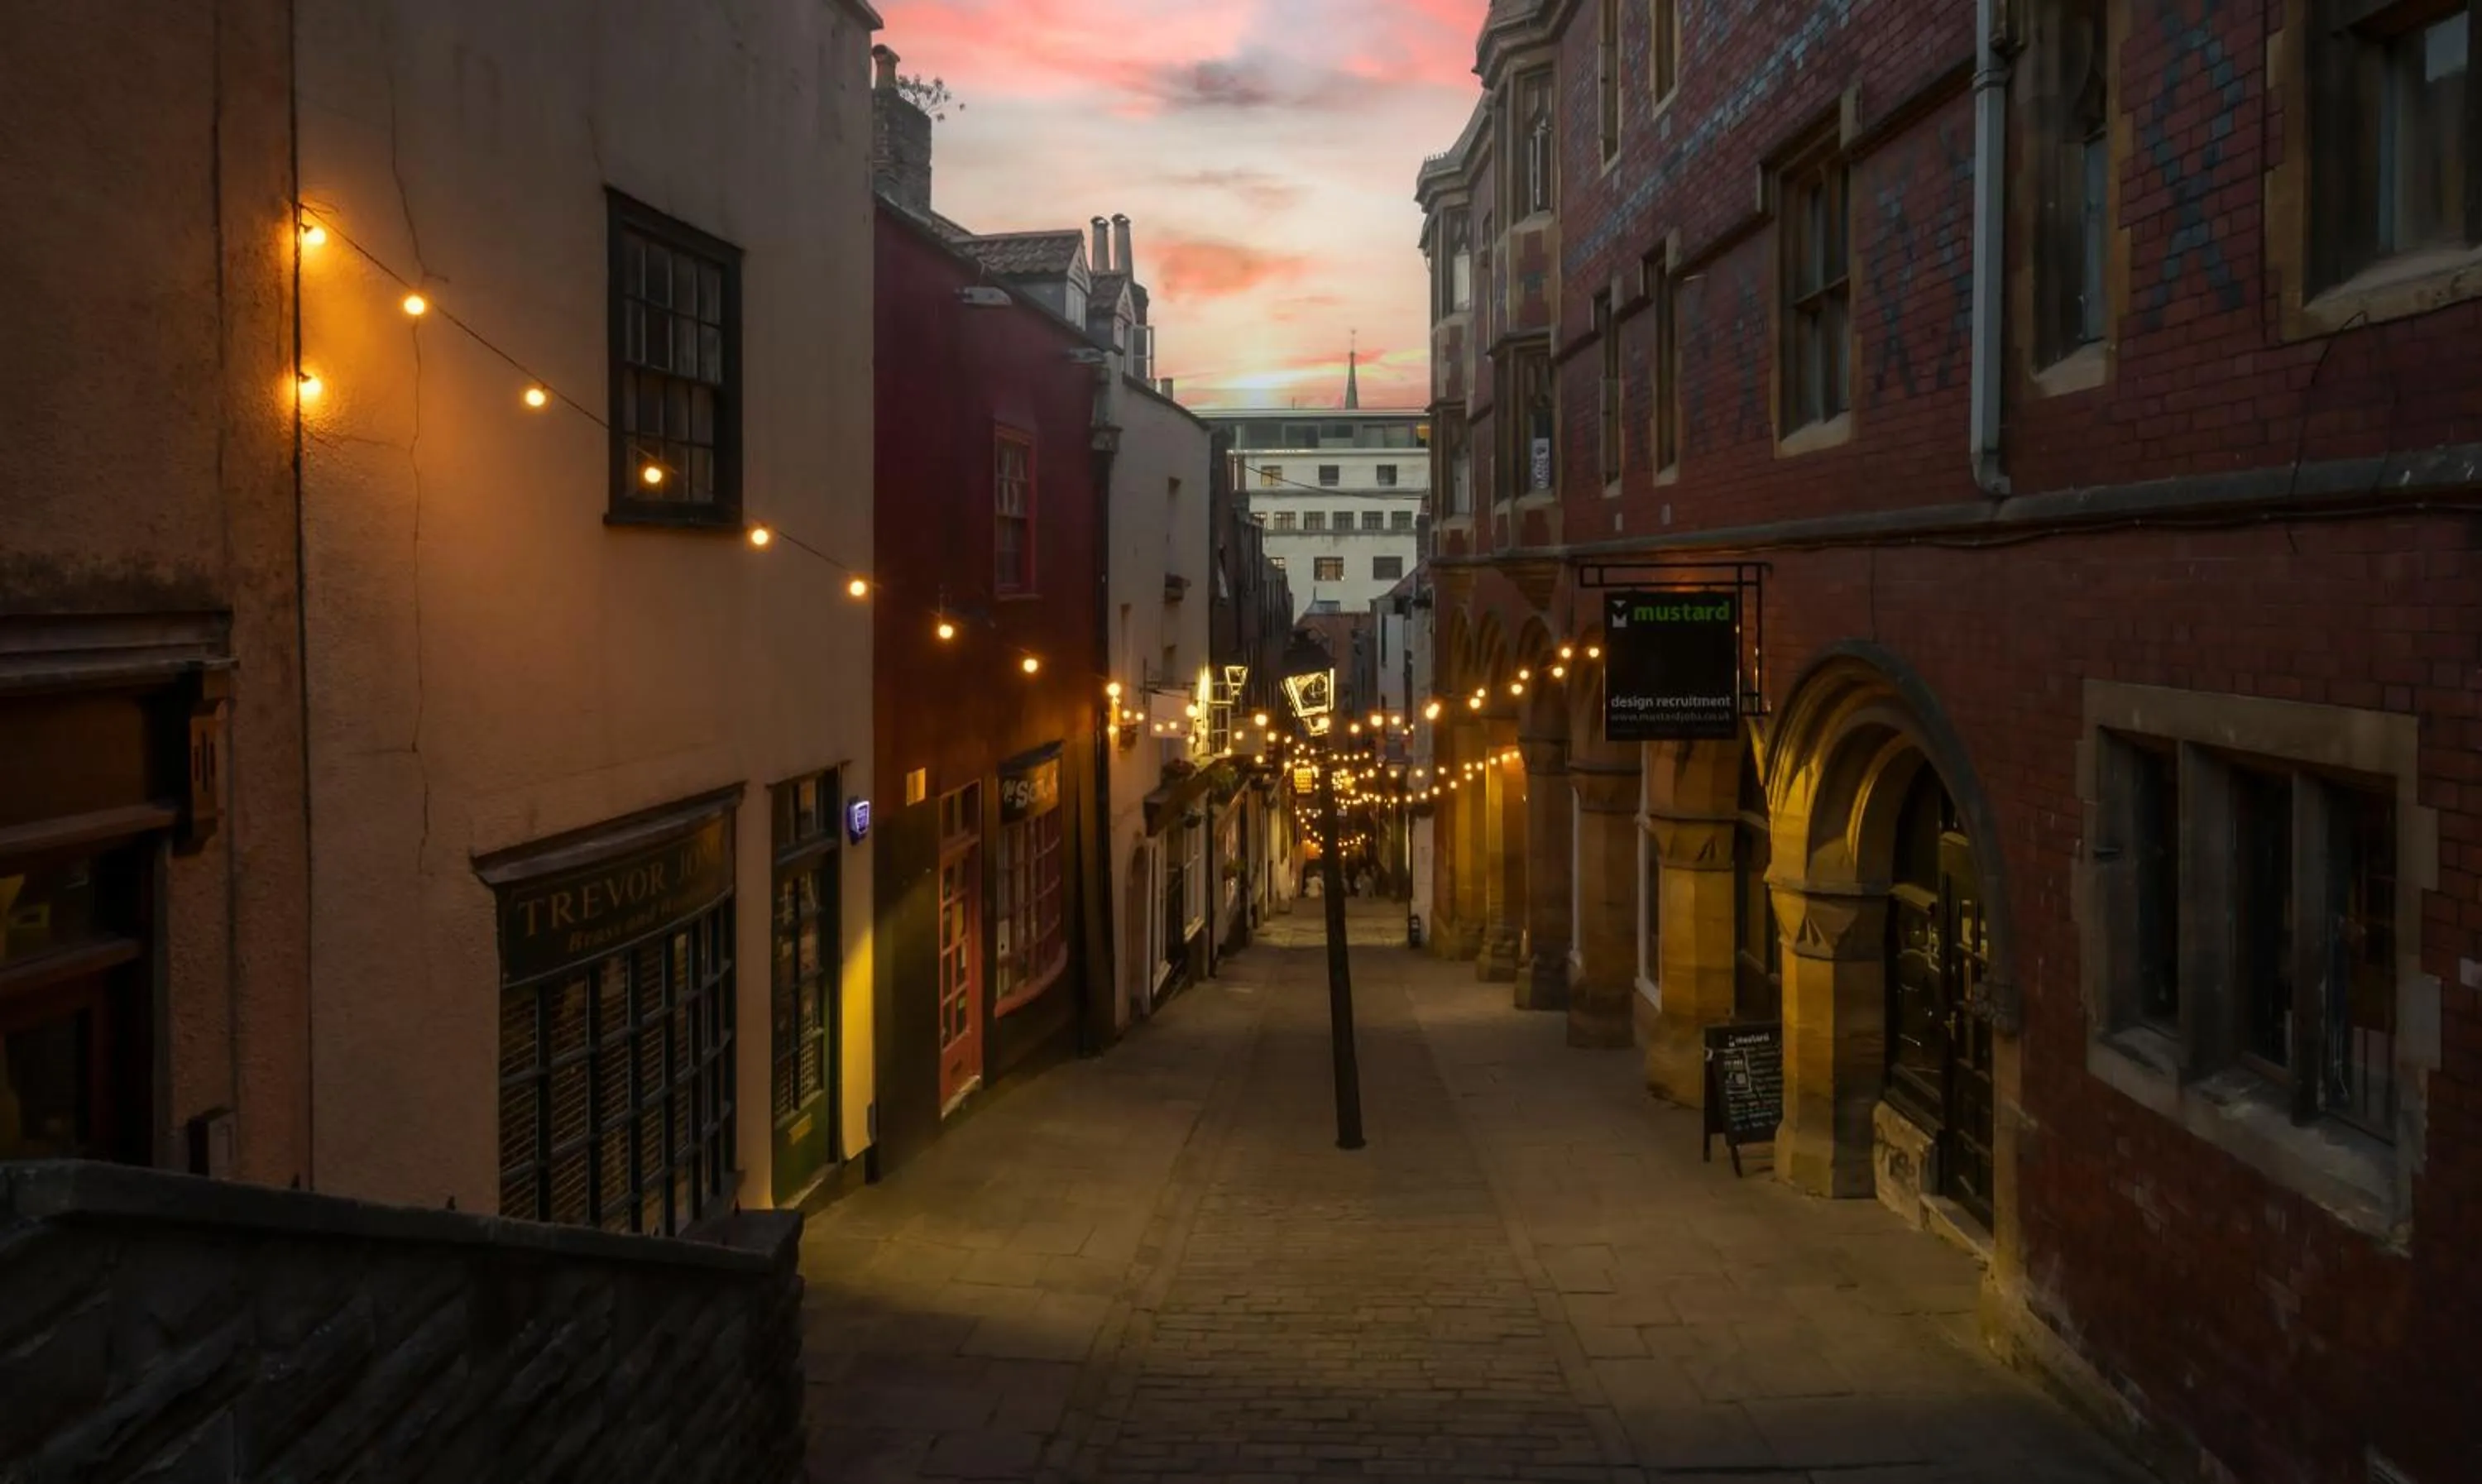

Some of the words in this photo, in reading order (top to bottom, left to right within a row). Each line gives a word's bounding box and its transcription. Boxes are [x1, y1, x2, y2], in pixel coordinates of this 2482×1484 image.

[1633, 601, 1731, 622] mustard
[1610, 694, 1654, 711] design
[1655, 694, 1732, 708] recruitment
[517, 861, 668, 937] TREVOR
